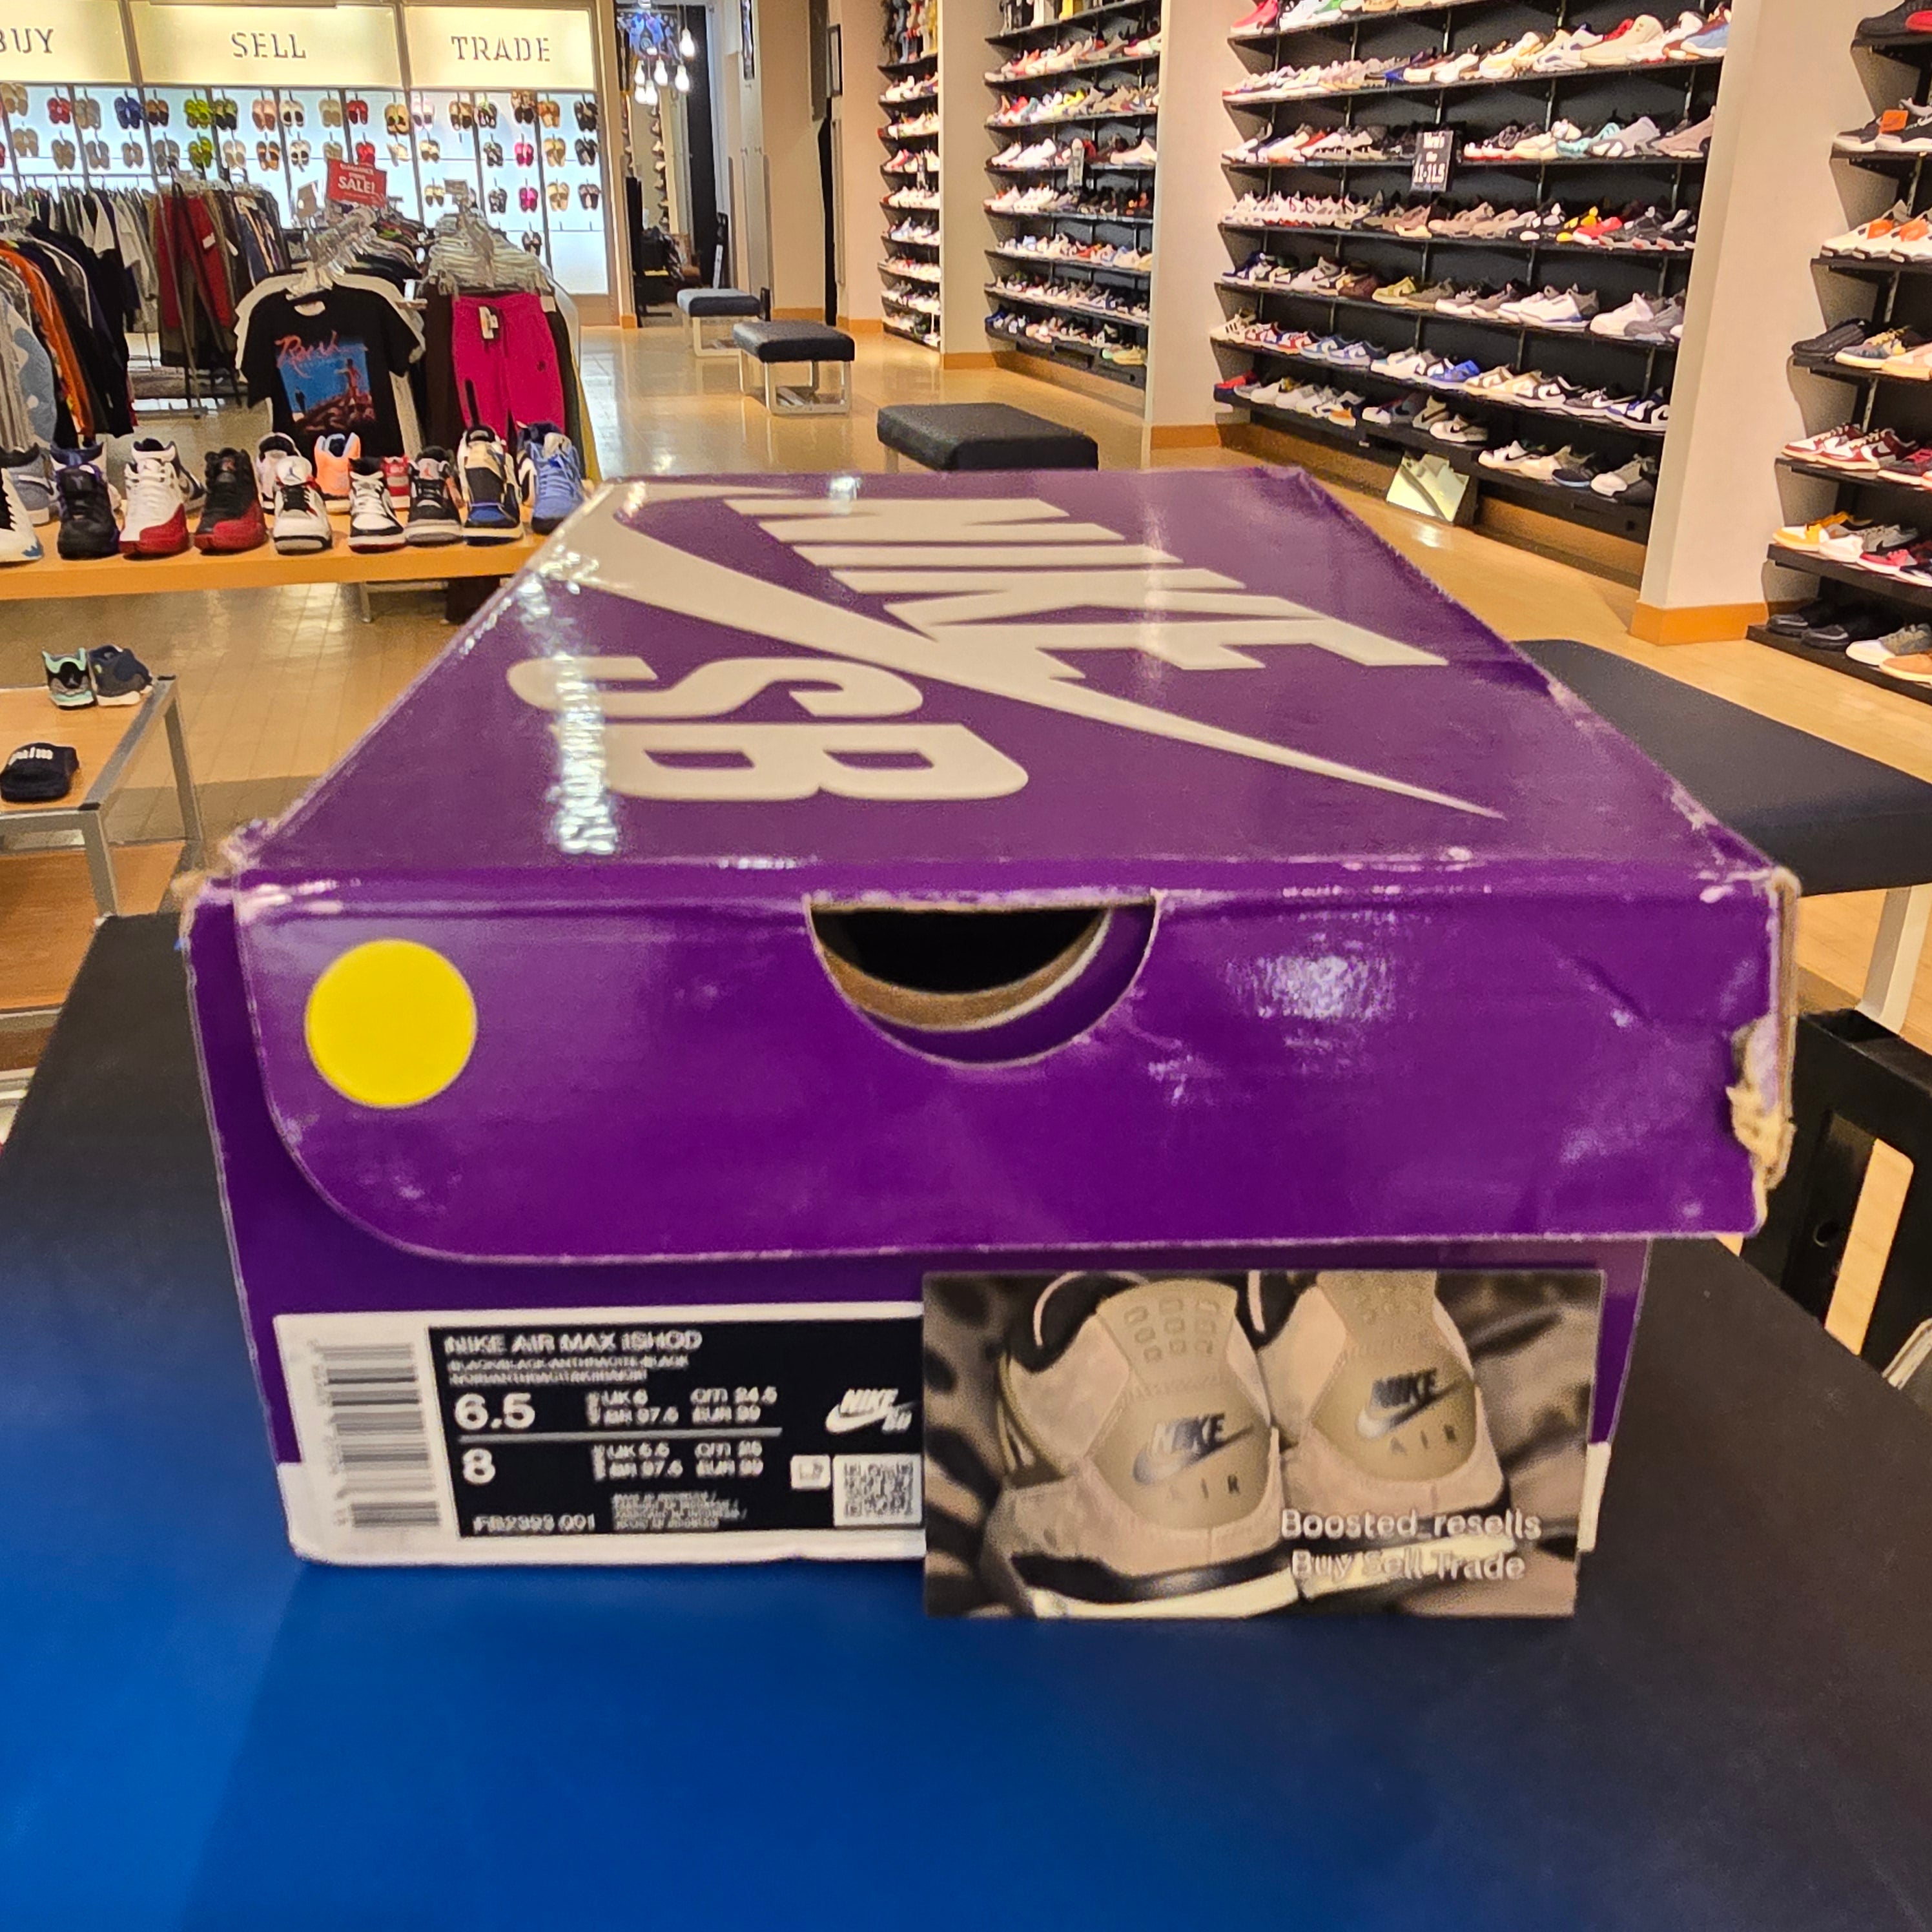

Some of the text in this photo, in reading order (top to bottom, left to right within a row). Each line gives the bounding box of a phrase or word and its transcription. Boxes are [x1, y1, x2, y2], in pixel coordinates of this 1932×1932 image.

[231, 32, 307, 59] SELL
[451, 36, 550, 62] TRADE
[723, 498, 1448, 679] NIKE
[506, 655, 1029, 802] SB
[444, 1334, 506, 1354] NIKE
[511, 1333, 555, 1353] AIR
[559, 1332, 617, 1353] MAX
[839, 1388, 899, 1415] NIKE
[1370, 1367, 1437, 1409] NIKE
[455, 1392, 535, 1431] 6.5
[462, 1448, 496, 1485] 8
[1291, 1548, 1526, 1581] Buy Sell Trade
